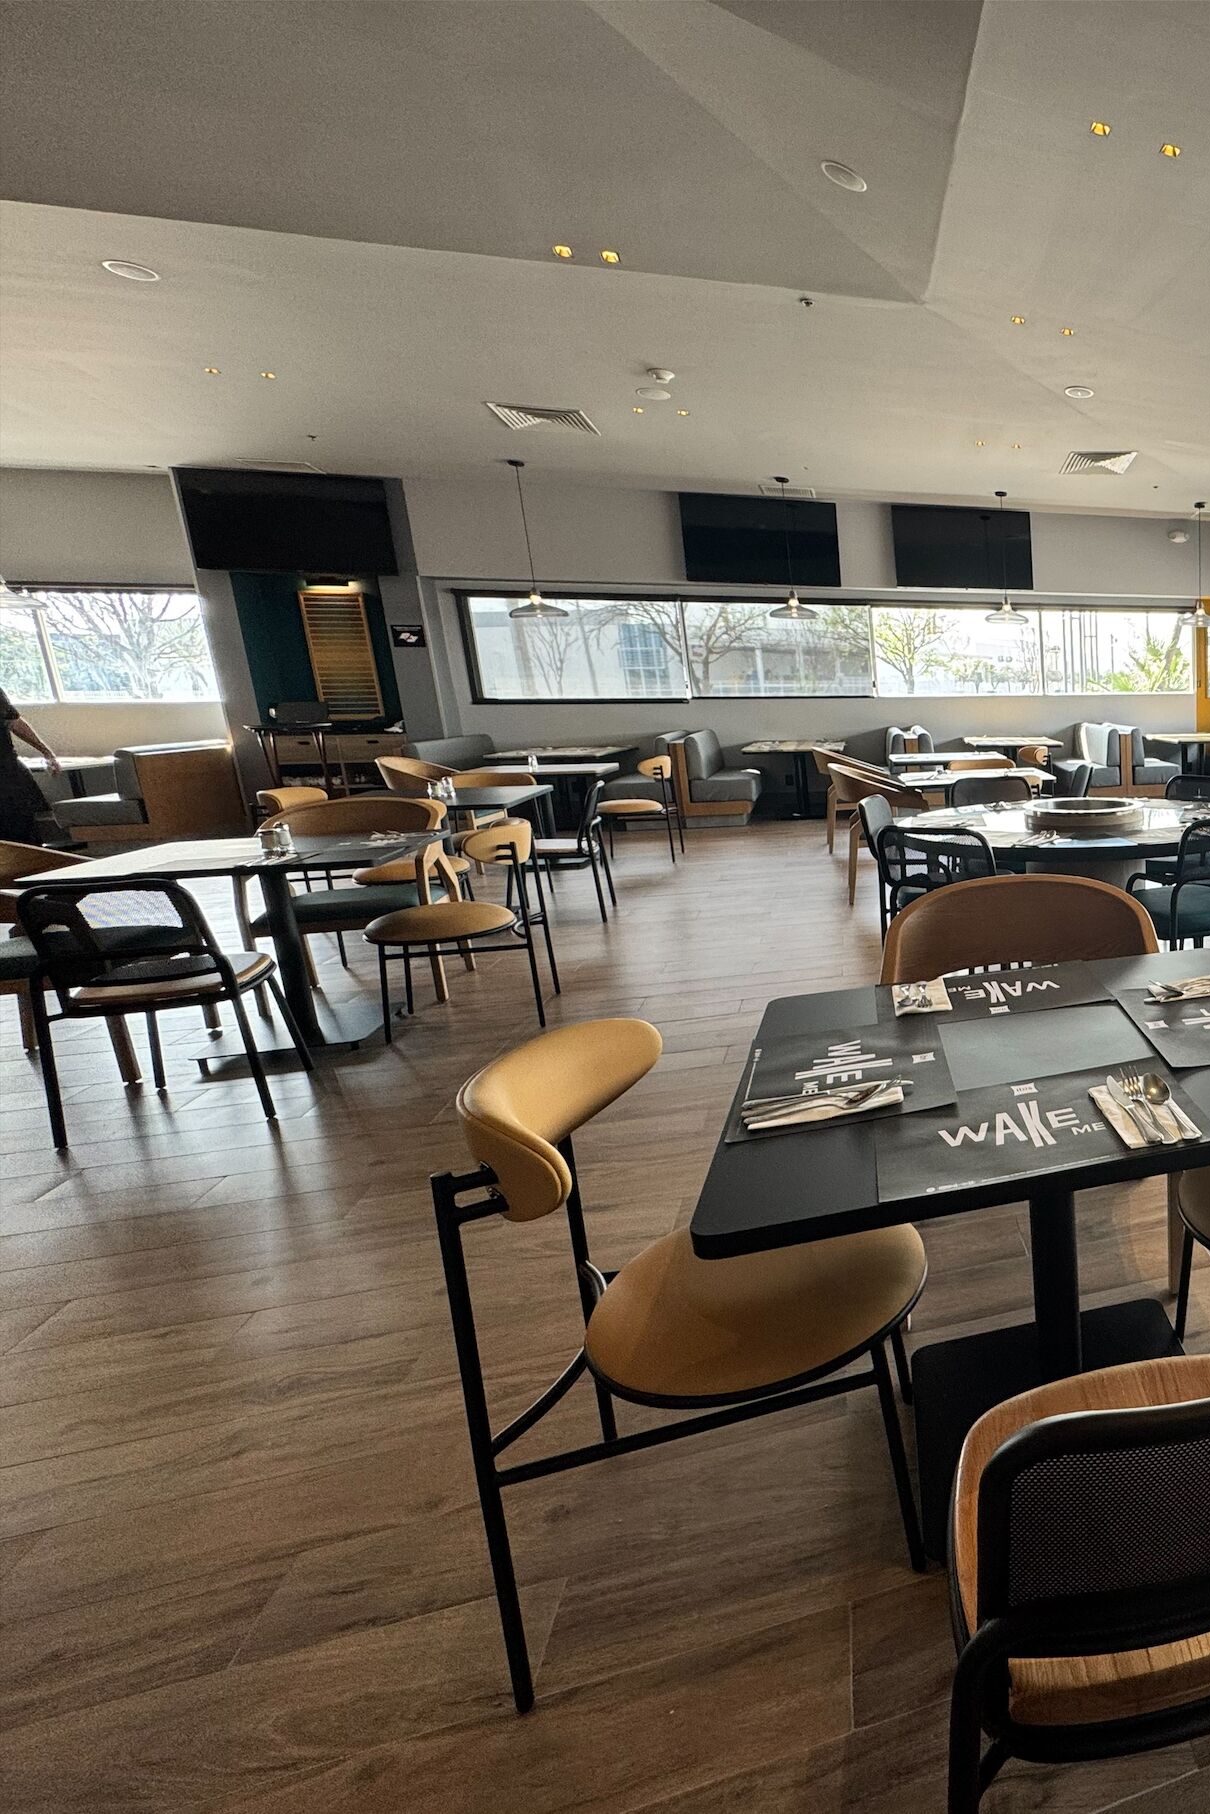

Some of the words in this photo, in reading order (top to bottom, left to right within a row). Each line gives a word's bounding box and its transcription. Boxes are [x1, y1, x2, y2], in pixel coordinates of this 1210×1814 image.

[965, 980, 1060, 1004] WAKE
[794, 1039, 894, 1084] WAKE
[938, 1100, 1080, 1148] WAKE
[1071, 1121, 1107, 1136] ME
